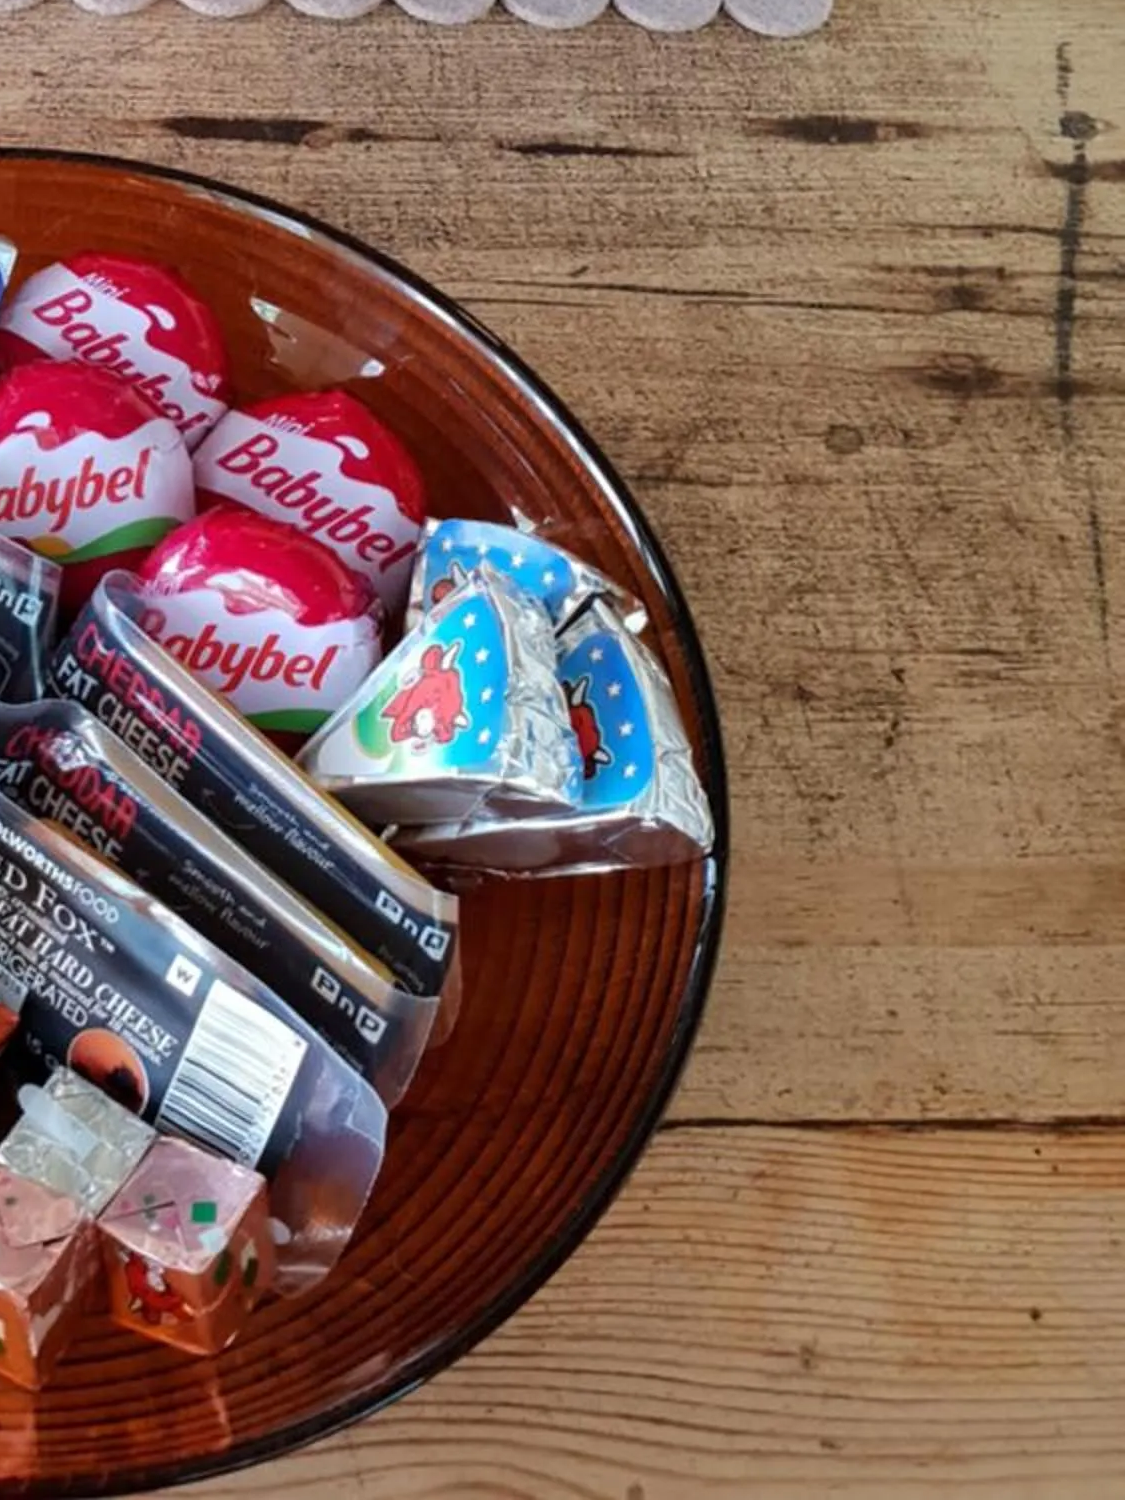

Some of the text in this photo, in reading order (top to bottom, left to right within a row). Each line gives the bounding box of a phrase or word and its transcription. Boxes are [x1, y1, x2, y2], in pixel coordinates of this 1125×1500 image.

[31, 287, 215, 437] Babybel
[215, 432, 419, 573] Babybel
[56, 654, 100, 701] FAT
[96, 692, 192, 784] CHEESE
[77, 625, 203, 758] CHEDDAR
[27, 774, 125, 863] CHEESE
[374, 889, 452, 963] PnP
[33, 931, 95, 989] HARD
[93, 982, 179, 1059] CHEESE
[309, 965, 389, 1046] PnP
